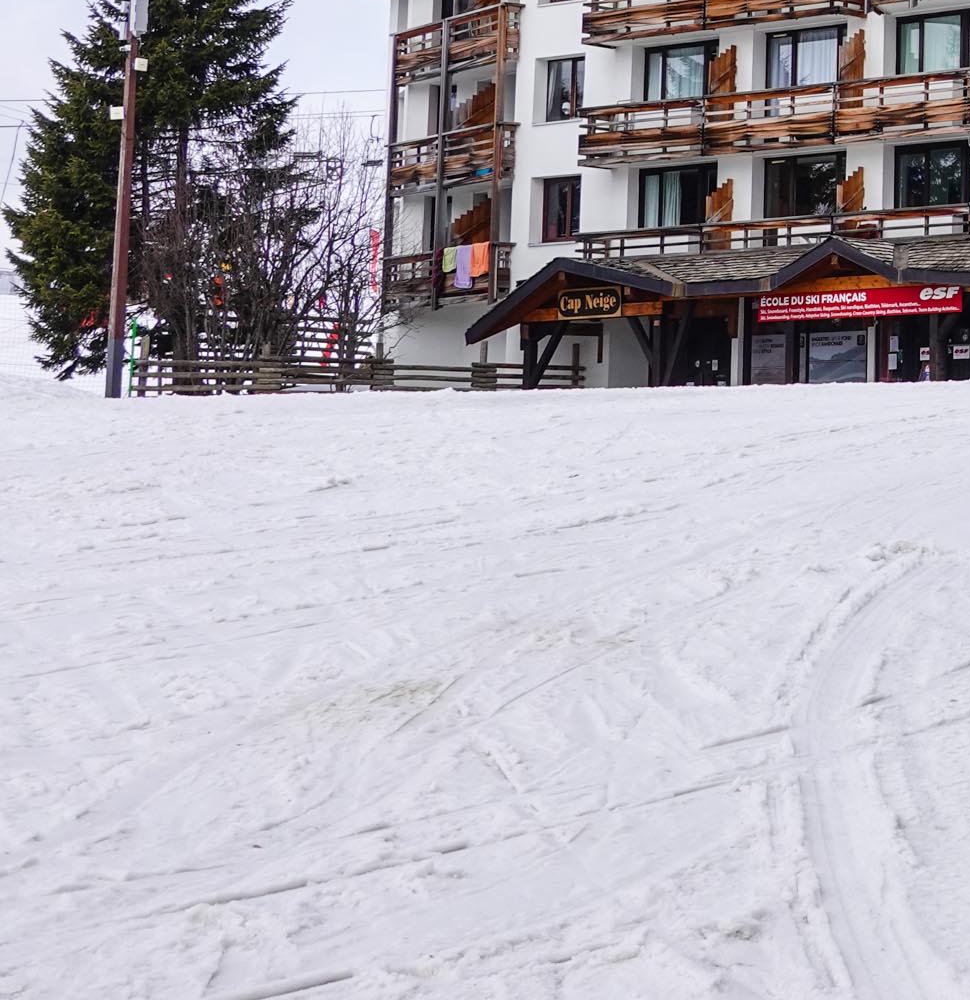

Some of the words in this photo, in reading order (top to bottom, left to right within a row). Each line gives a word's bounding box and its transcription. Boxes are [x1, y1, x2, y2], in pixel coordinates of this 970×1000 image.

[560, 296, 582, 314] Cap
[584, 292, 616, 312] Neige
[760, 296, 789, 307] ÉCOLE
[790, 296, 804, 304] DU
[806, 295, 820, 304] SKI
[821, 292, 867, 304] FRANÇAIS
